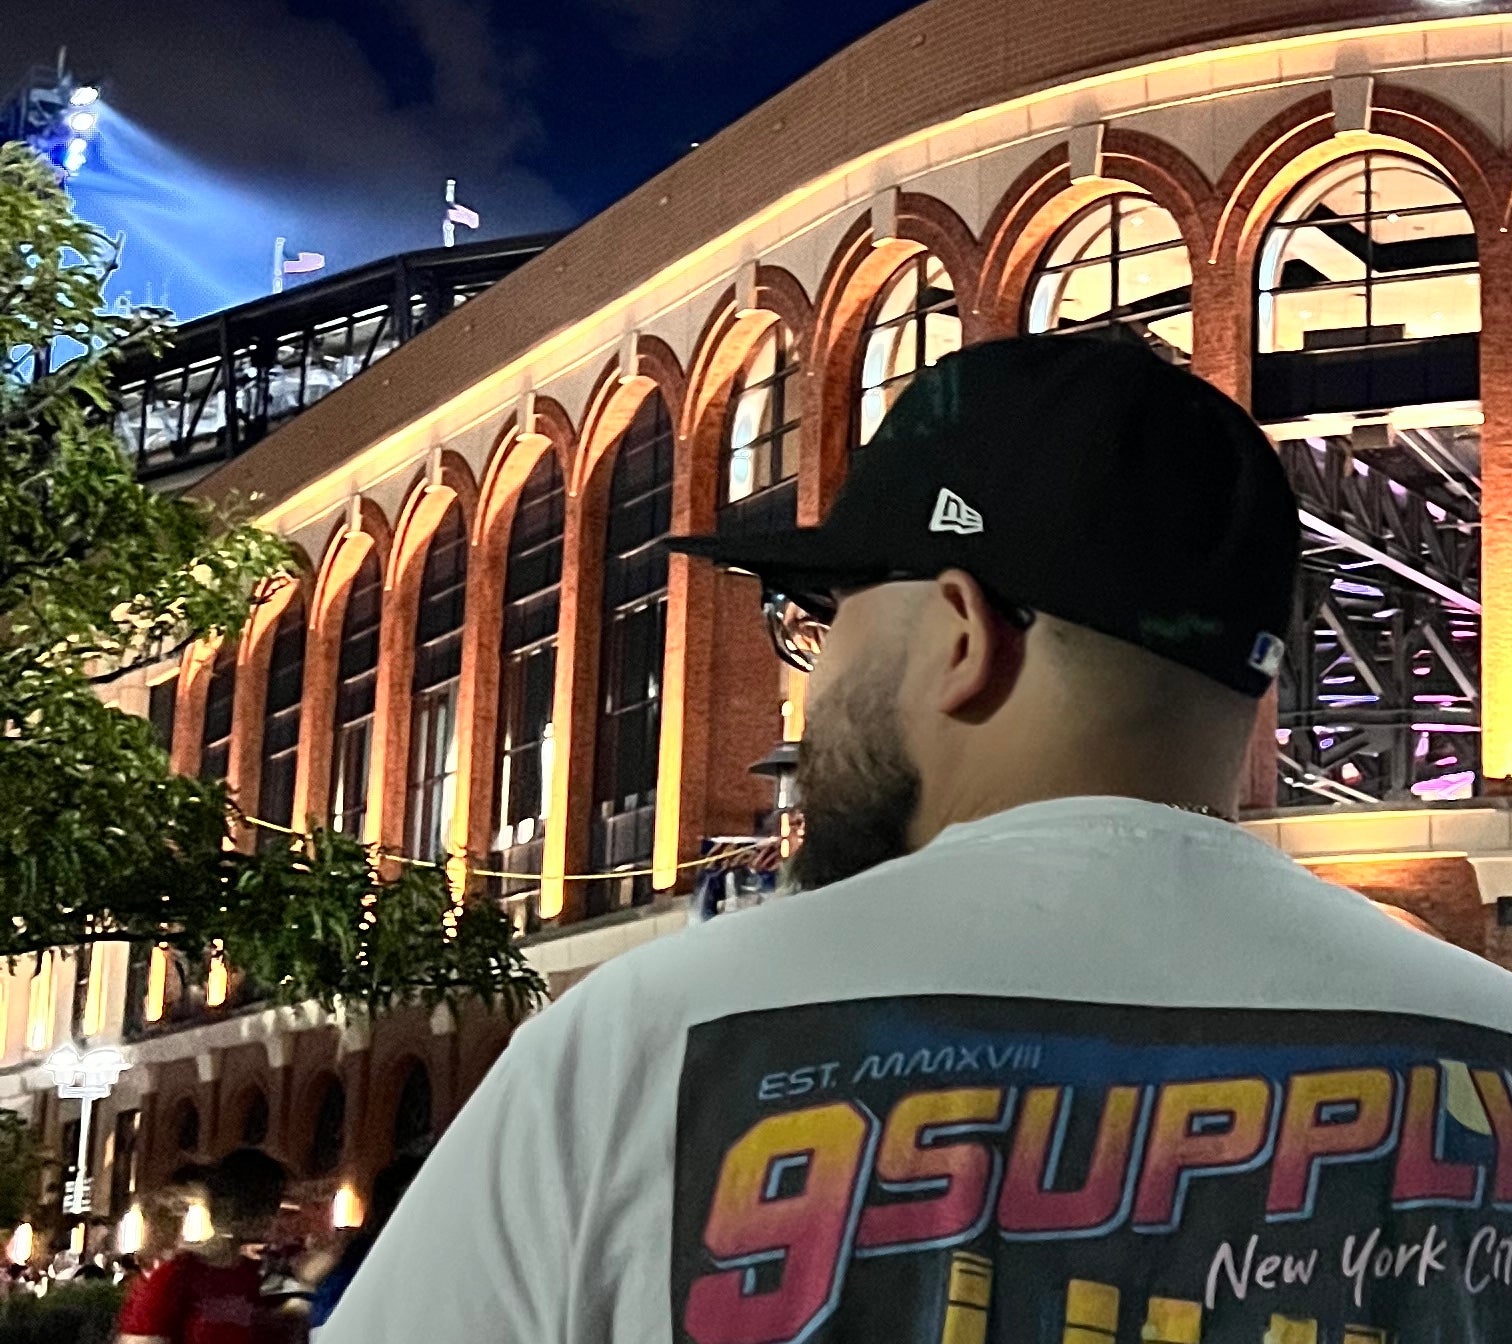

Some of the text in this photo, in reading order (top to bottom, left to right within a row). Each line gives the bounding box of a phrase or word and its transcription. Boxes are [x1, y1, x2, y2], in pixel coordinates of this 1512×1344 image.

[758, 1061, 841, 1101] EST.
[1204, 1233, 1319, 1310] New
[1341, 1223, 1448, 1308] York
